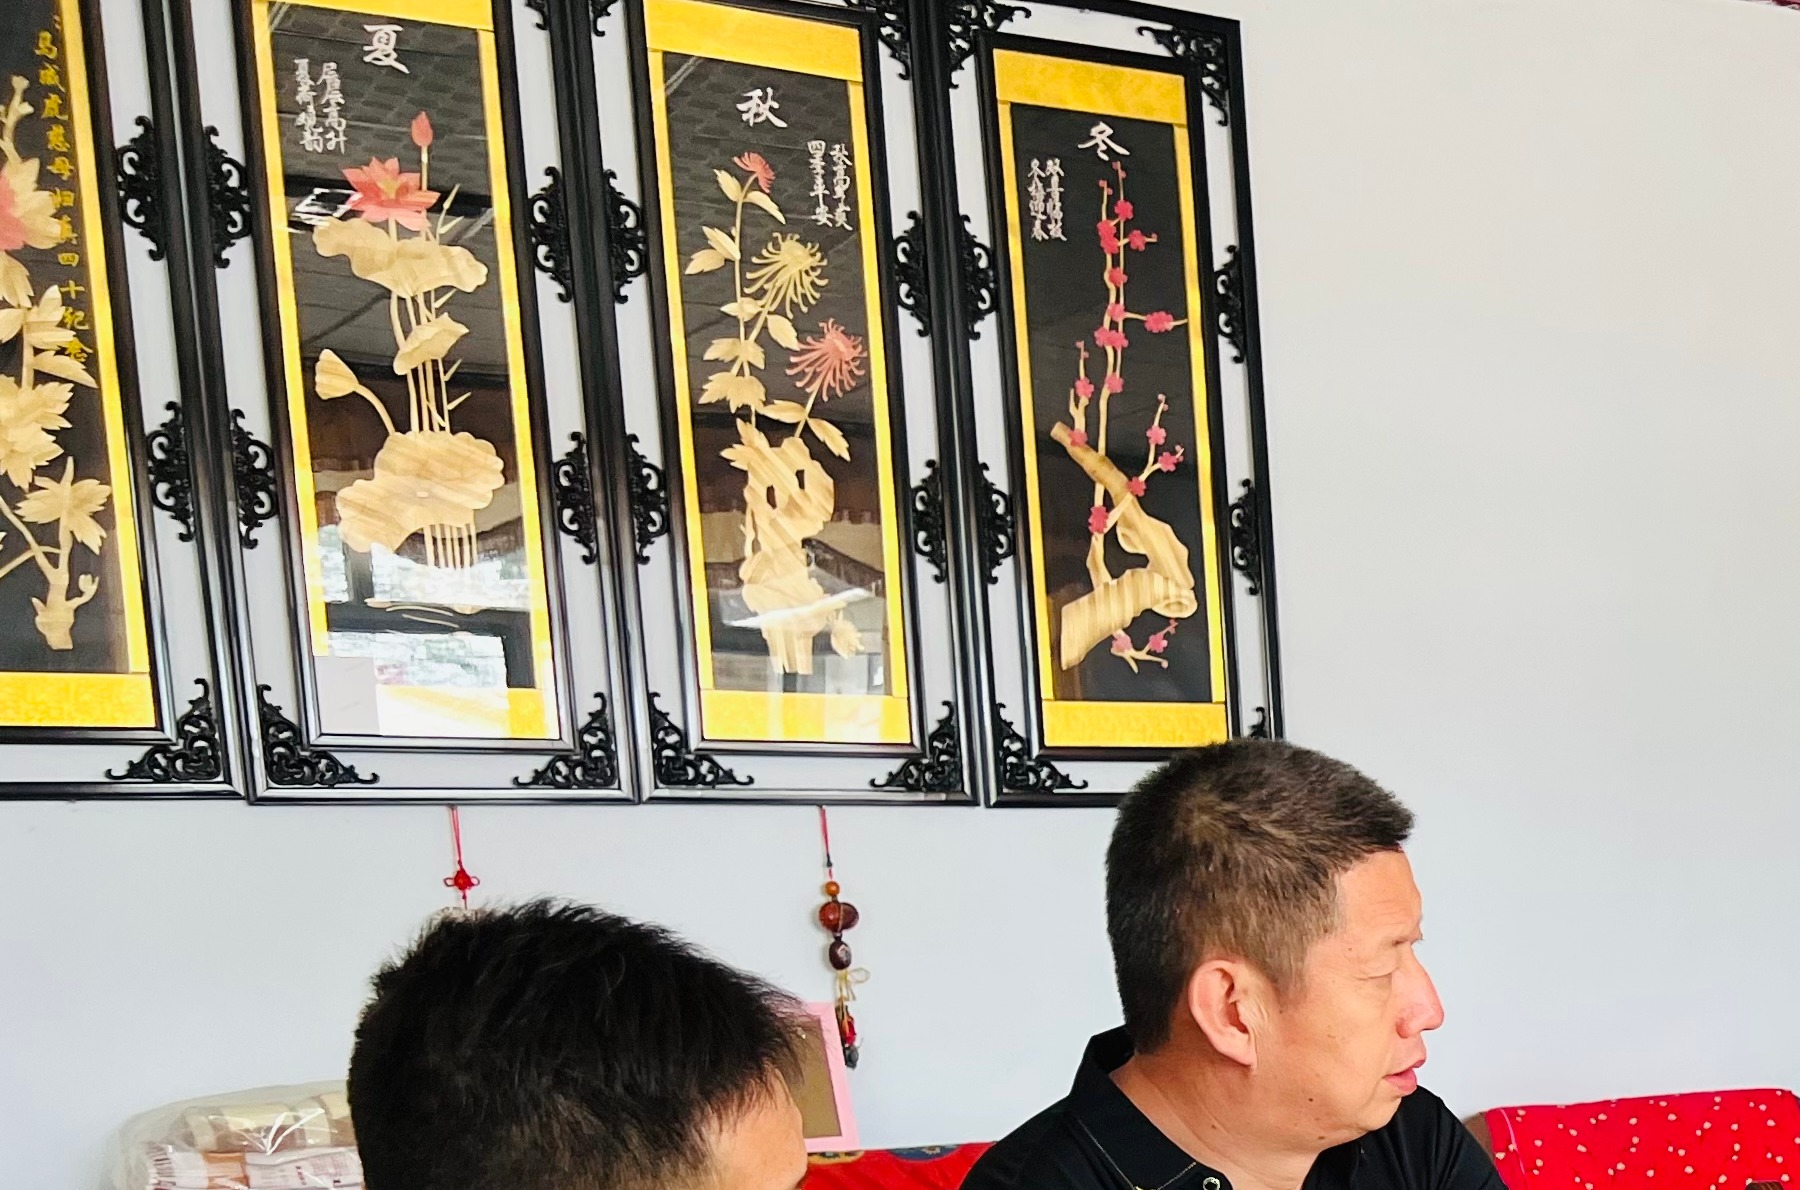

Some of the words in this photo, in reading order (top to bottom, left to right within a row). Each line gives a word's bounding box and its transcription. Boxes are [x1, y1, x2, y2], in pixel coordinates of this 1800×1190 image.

[363, 24, 410, 74] 夏
[736, 87, 788, 128] 秋
[1077, 121, 1131, 162] 冬
